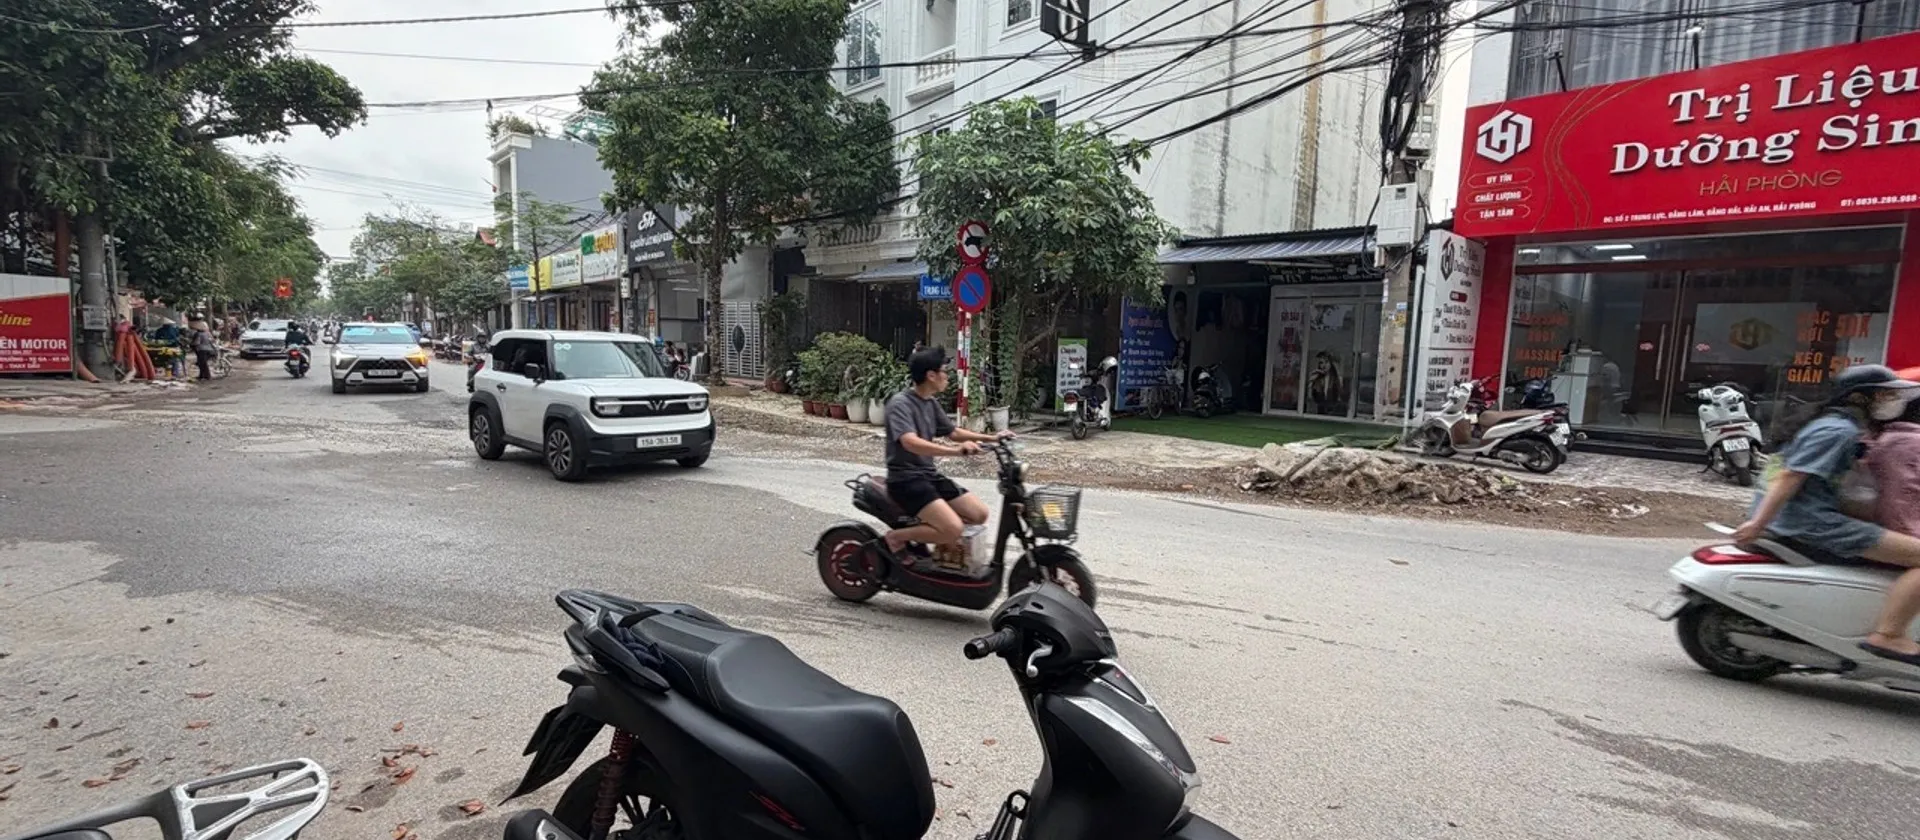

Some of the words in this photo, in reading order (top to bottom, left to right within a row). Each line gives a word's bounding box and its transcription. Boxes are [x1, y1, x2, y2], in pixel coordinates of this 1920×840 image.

[1669, 84, 1751, 122] Trị
[1771, 64, 1920, 110] Liệu
[1609, 129, 1800, 174] Dưỡng
[1700, 173, 1738, 196] HẢI
[1745, 169, 1843, 192] PHÒNG
[0, 312, 32, 326] line
[21, 339, 67, 350] MOTOR
